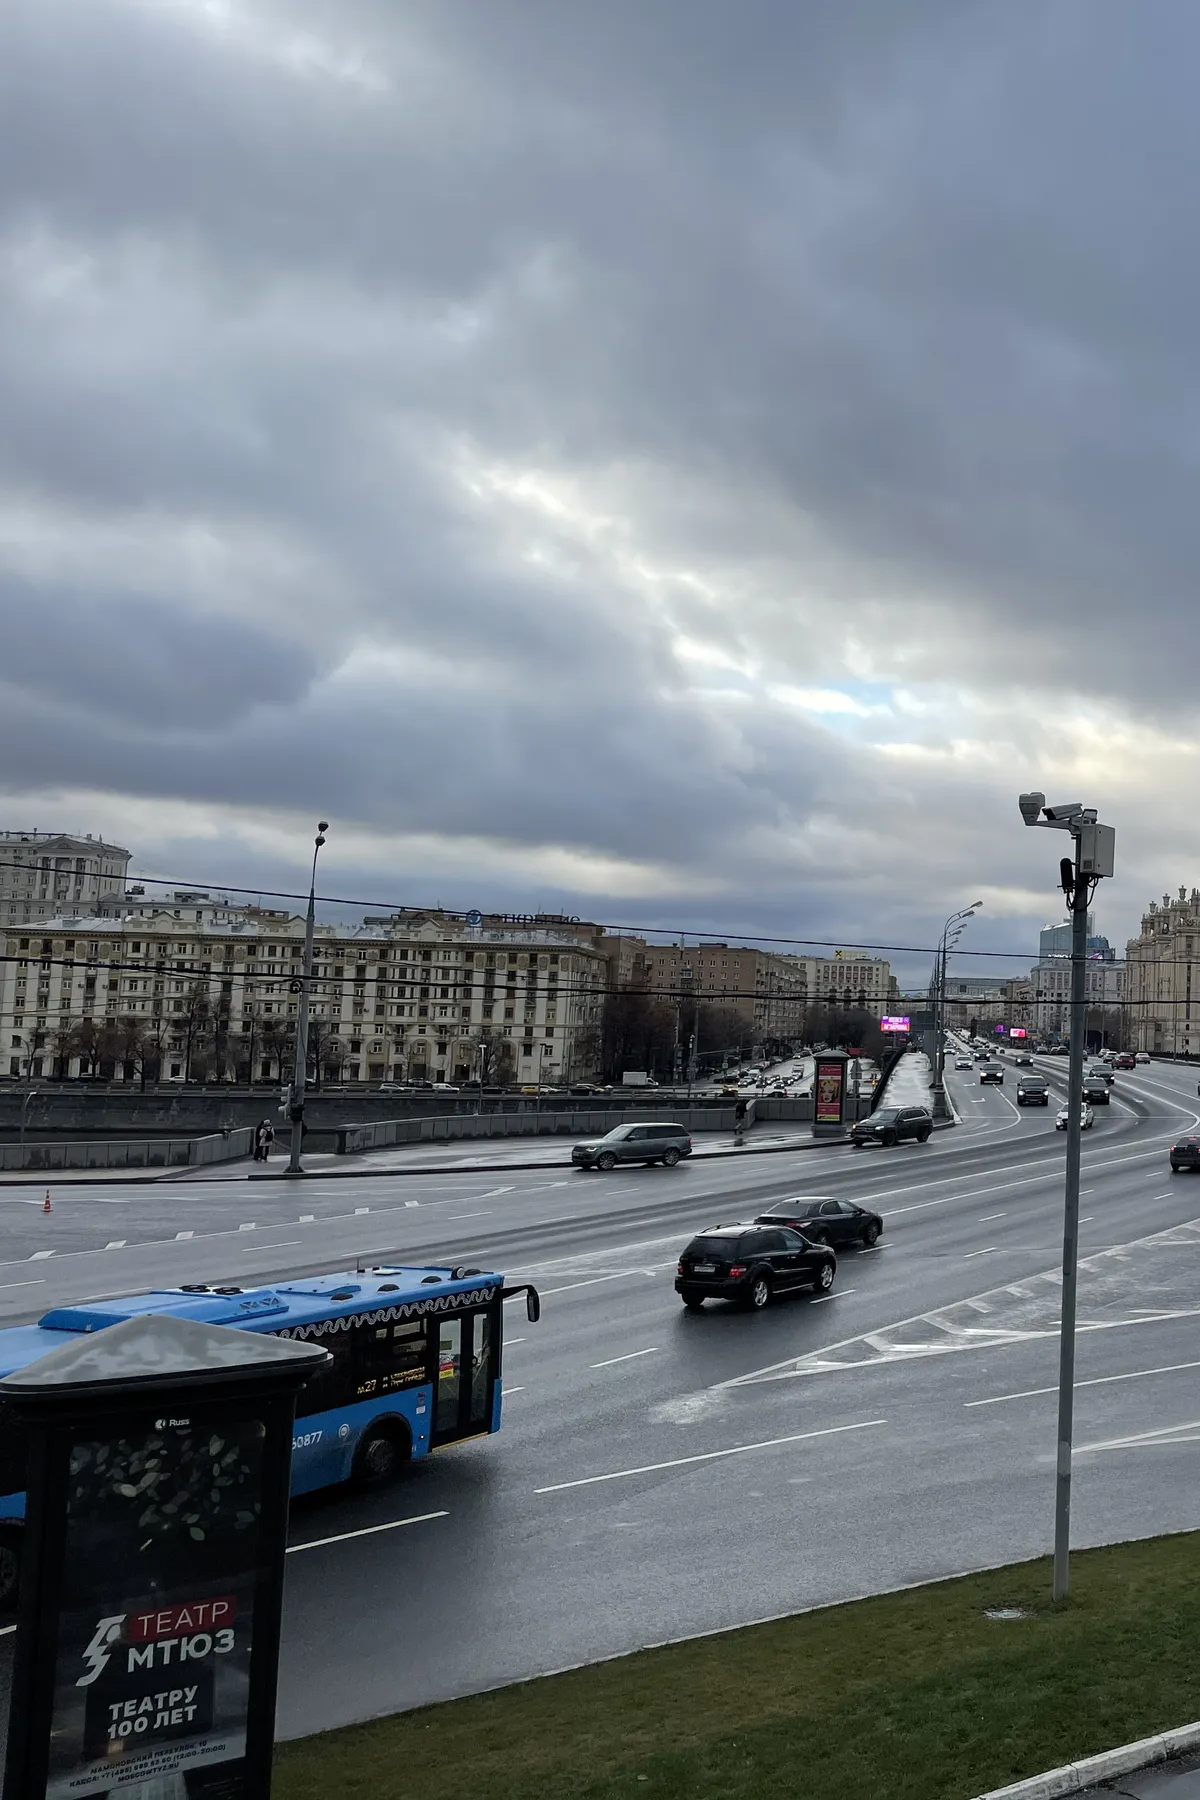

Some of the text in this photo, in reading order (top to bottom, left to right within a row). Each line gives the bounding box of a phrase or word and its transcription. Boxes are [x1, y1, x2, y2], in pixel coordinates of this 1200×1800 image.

[169, 1419, 190, 1427] Russ
[137, 1601, 229, 1637] ТЕАТР
[127, 1628, 235, 1673] МТЮЗ
[108, 1685, 198, 1721] ТЕАТРУ
[107, 1704, 198, 1740] 100 ЛЕТ
